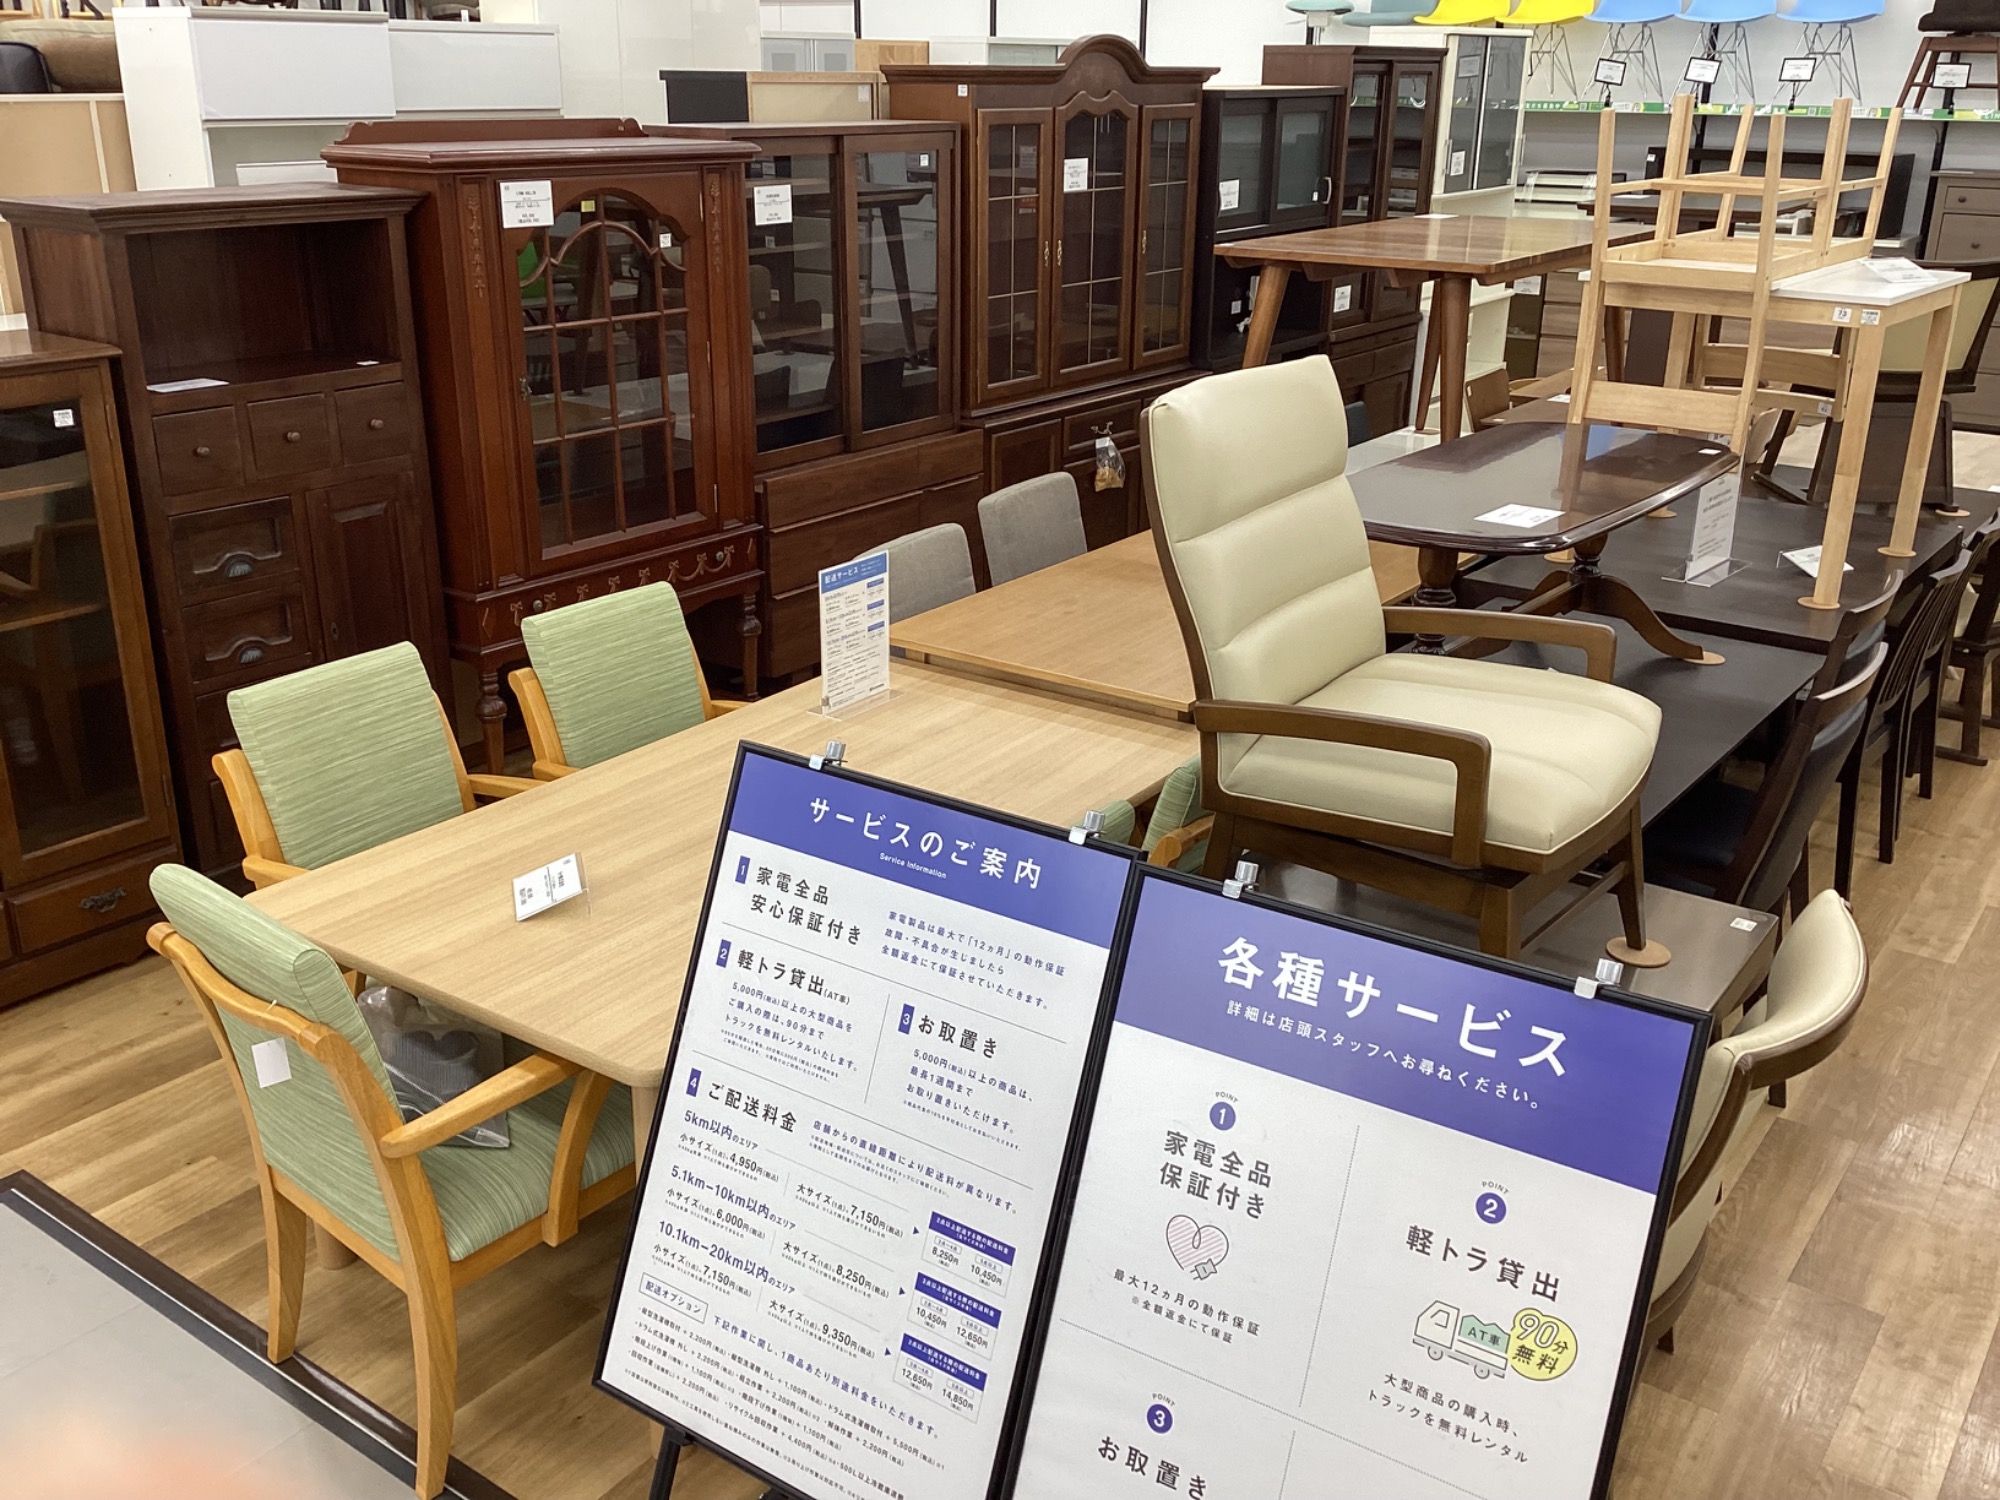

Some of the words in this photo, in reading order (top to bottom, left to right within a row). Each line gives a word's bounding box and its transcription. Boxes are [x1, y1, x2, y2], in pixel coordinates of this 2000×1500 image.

[1838, 309, 1848, 317] 73
[810, 797, 1042, 890] サービスのご案内
[878, 852, 905, 866] Service
[905, 860, 948, 881] Information
[756, 866, 829, 906] 家電全品
[750, 893, 861, 946] 安心保証付き
[884, 927, 1004, 976] 故障・不具合が生じましたら
[881, 944, 1047, 1010] 全額返金にて保証させていただきます。
[728, 997, 825, 1040] ご購入の際は、90分まで
[1217, 936, 1570, 1077] 各種サービス
[725, 1013, 857, 1072] トラックを無料レンタルいたします。
[918, 1014, 997, 1059] お取置き
[1226, 999, 1542, 1111] 詳細は店頭スタッフへお尋ねください。
[910, 1065, 973, 1097] 最長1週間まで
[1215, 1091, 1239, 1103] POINT
[684, 1109, 759, 1150] 5km以内のエリア
[708, 1082, 797, 1133] ご配送料金
[906, 1083, 1014, 1134] お取り置きいただけます。
[1219, 1107, 1227, 1125] 1
[813, 1120, 1017, 1214] 店舗からの直線距離により配送料が異なります。
[1163, 1130, 1272, 1189] 家電全品
[1159, 1161, 1265, 1220] 保証付き
[1481, 1180, 1510, 1195] POINT
[1483, 1198, 1499, 1219] 2
[1405, 1224, 1560, 1303] 軽トラ貸出
[645, 1280, 701, 1314] 配送オプション
[1113, 1268, 1260, 1337] 最大12ヵ月の動作保証
[1131, 1296, 1233, 1344] ※全額返金にて保証
[1467, 1326, 1501, 1346] AT車
[1515, 1311, 1571, 1356] 90分
[714, 1315, 938, 1439] 下記作業に関し、1商品あたり別途料金をいただきます。
[1510, 1343, 1562, 1375] 無料
[1152, 1392, 1176, 1407] POINT
[1153, 1410, 1166, 1428] 3
[1383, 1373, 1518, 1437] 大型商品の購入時、
[1369, 1389, 1528, 1463] トラックを無料レンタル
[1097, 1435, 1207, 1500] お取置き
